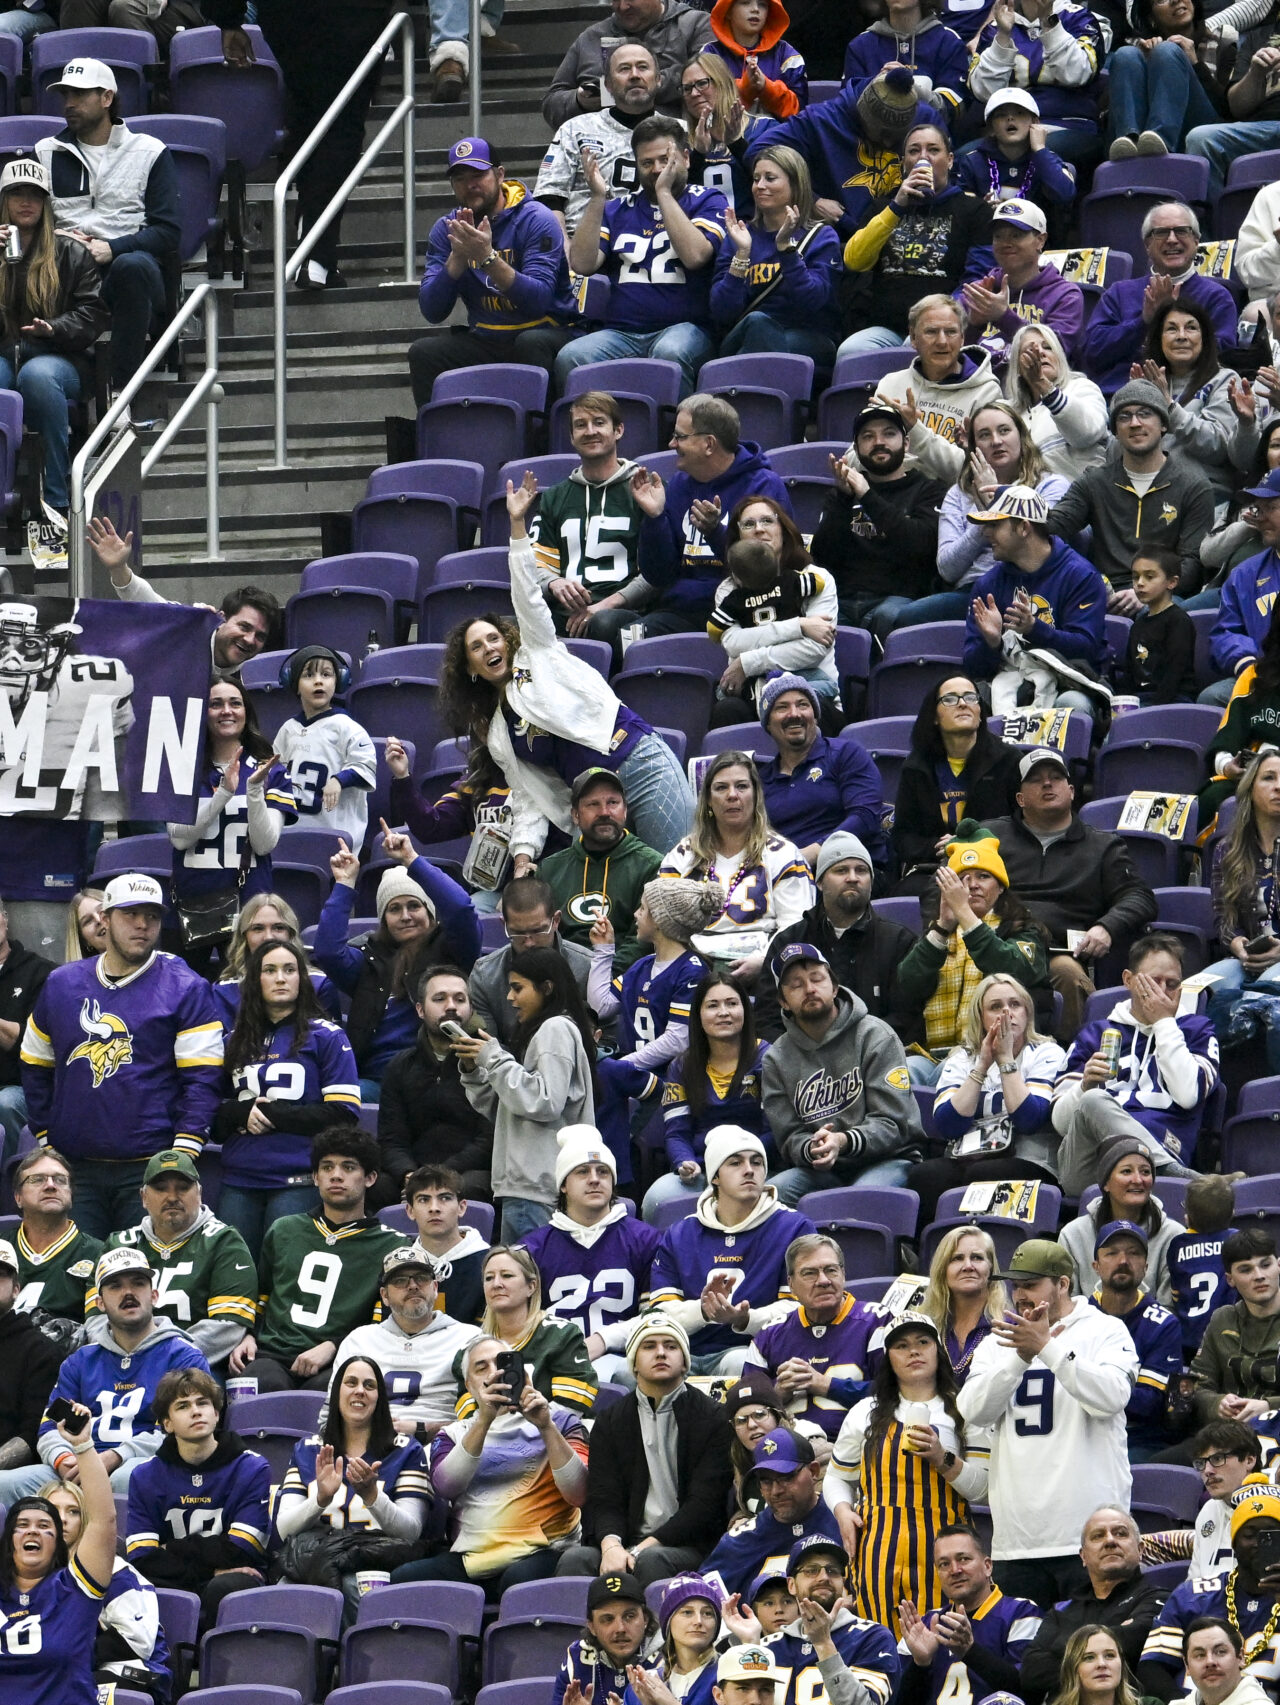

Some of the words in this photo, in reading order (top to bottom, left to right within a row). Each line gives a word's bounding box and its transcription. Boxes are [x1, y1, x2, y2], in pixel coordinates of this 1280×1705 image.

[11, 164, 43, 183] VIKES
[614, 231, 686, 284] 22
[998, 494, 1049, 520] VIKIN
[560, 516, 631, 583] 15
[634, 1006, 660, 1049] 9
[793, 1067, 863, 1120] Vikings
[803, 1106, 840, 1122] MINNESOTA
[107, 1248, 141, 1264] VIKINGS
[713, 1253, 743, 1264] VIKINGS
[1177, 1241, 1223, 1263] ADDISO
[291, 1251, 343, 1328] 9
[549, 1268, 634, 1336] 22
[1187, 1270, 1220, 1318] 3
[1014, 1369, 1054, 1436] 9
[180, 1494, 212, 1505] VIKINGS
[165, 1507, 224, 1540] 10
[937, 1661, 974, 1705] 4
